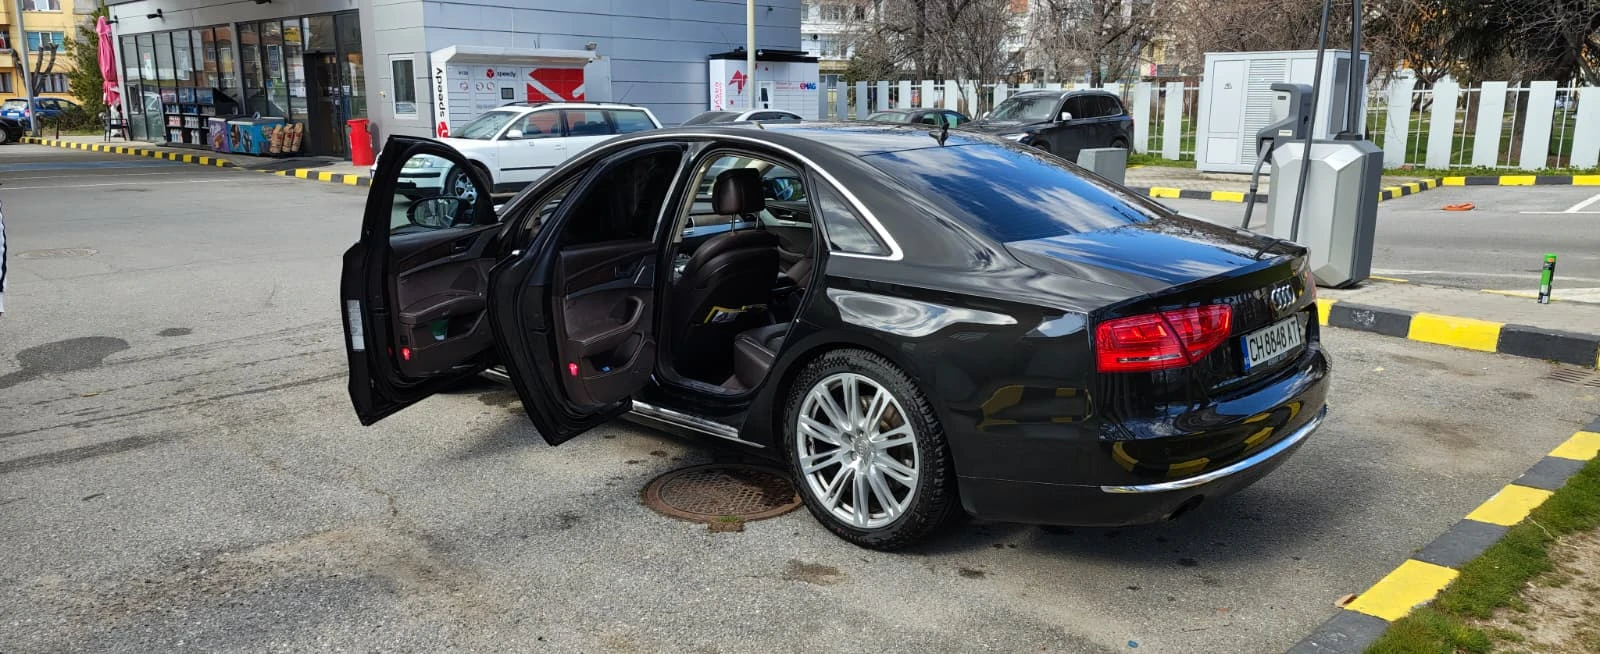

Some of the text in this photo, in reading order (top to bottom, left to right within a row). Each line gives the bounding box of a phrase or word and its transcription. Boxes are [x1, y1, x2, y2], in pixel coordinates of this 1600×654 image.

[435, 67, 446, 118] speedy
[1249, 320, 1298, 361] CH 8848 AT
